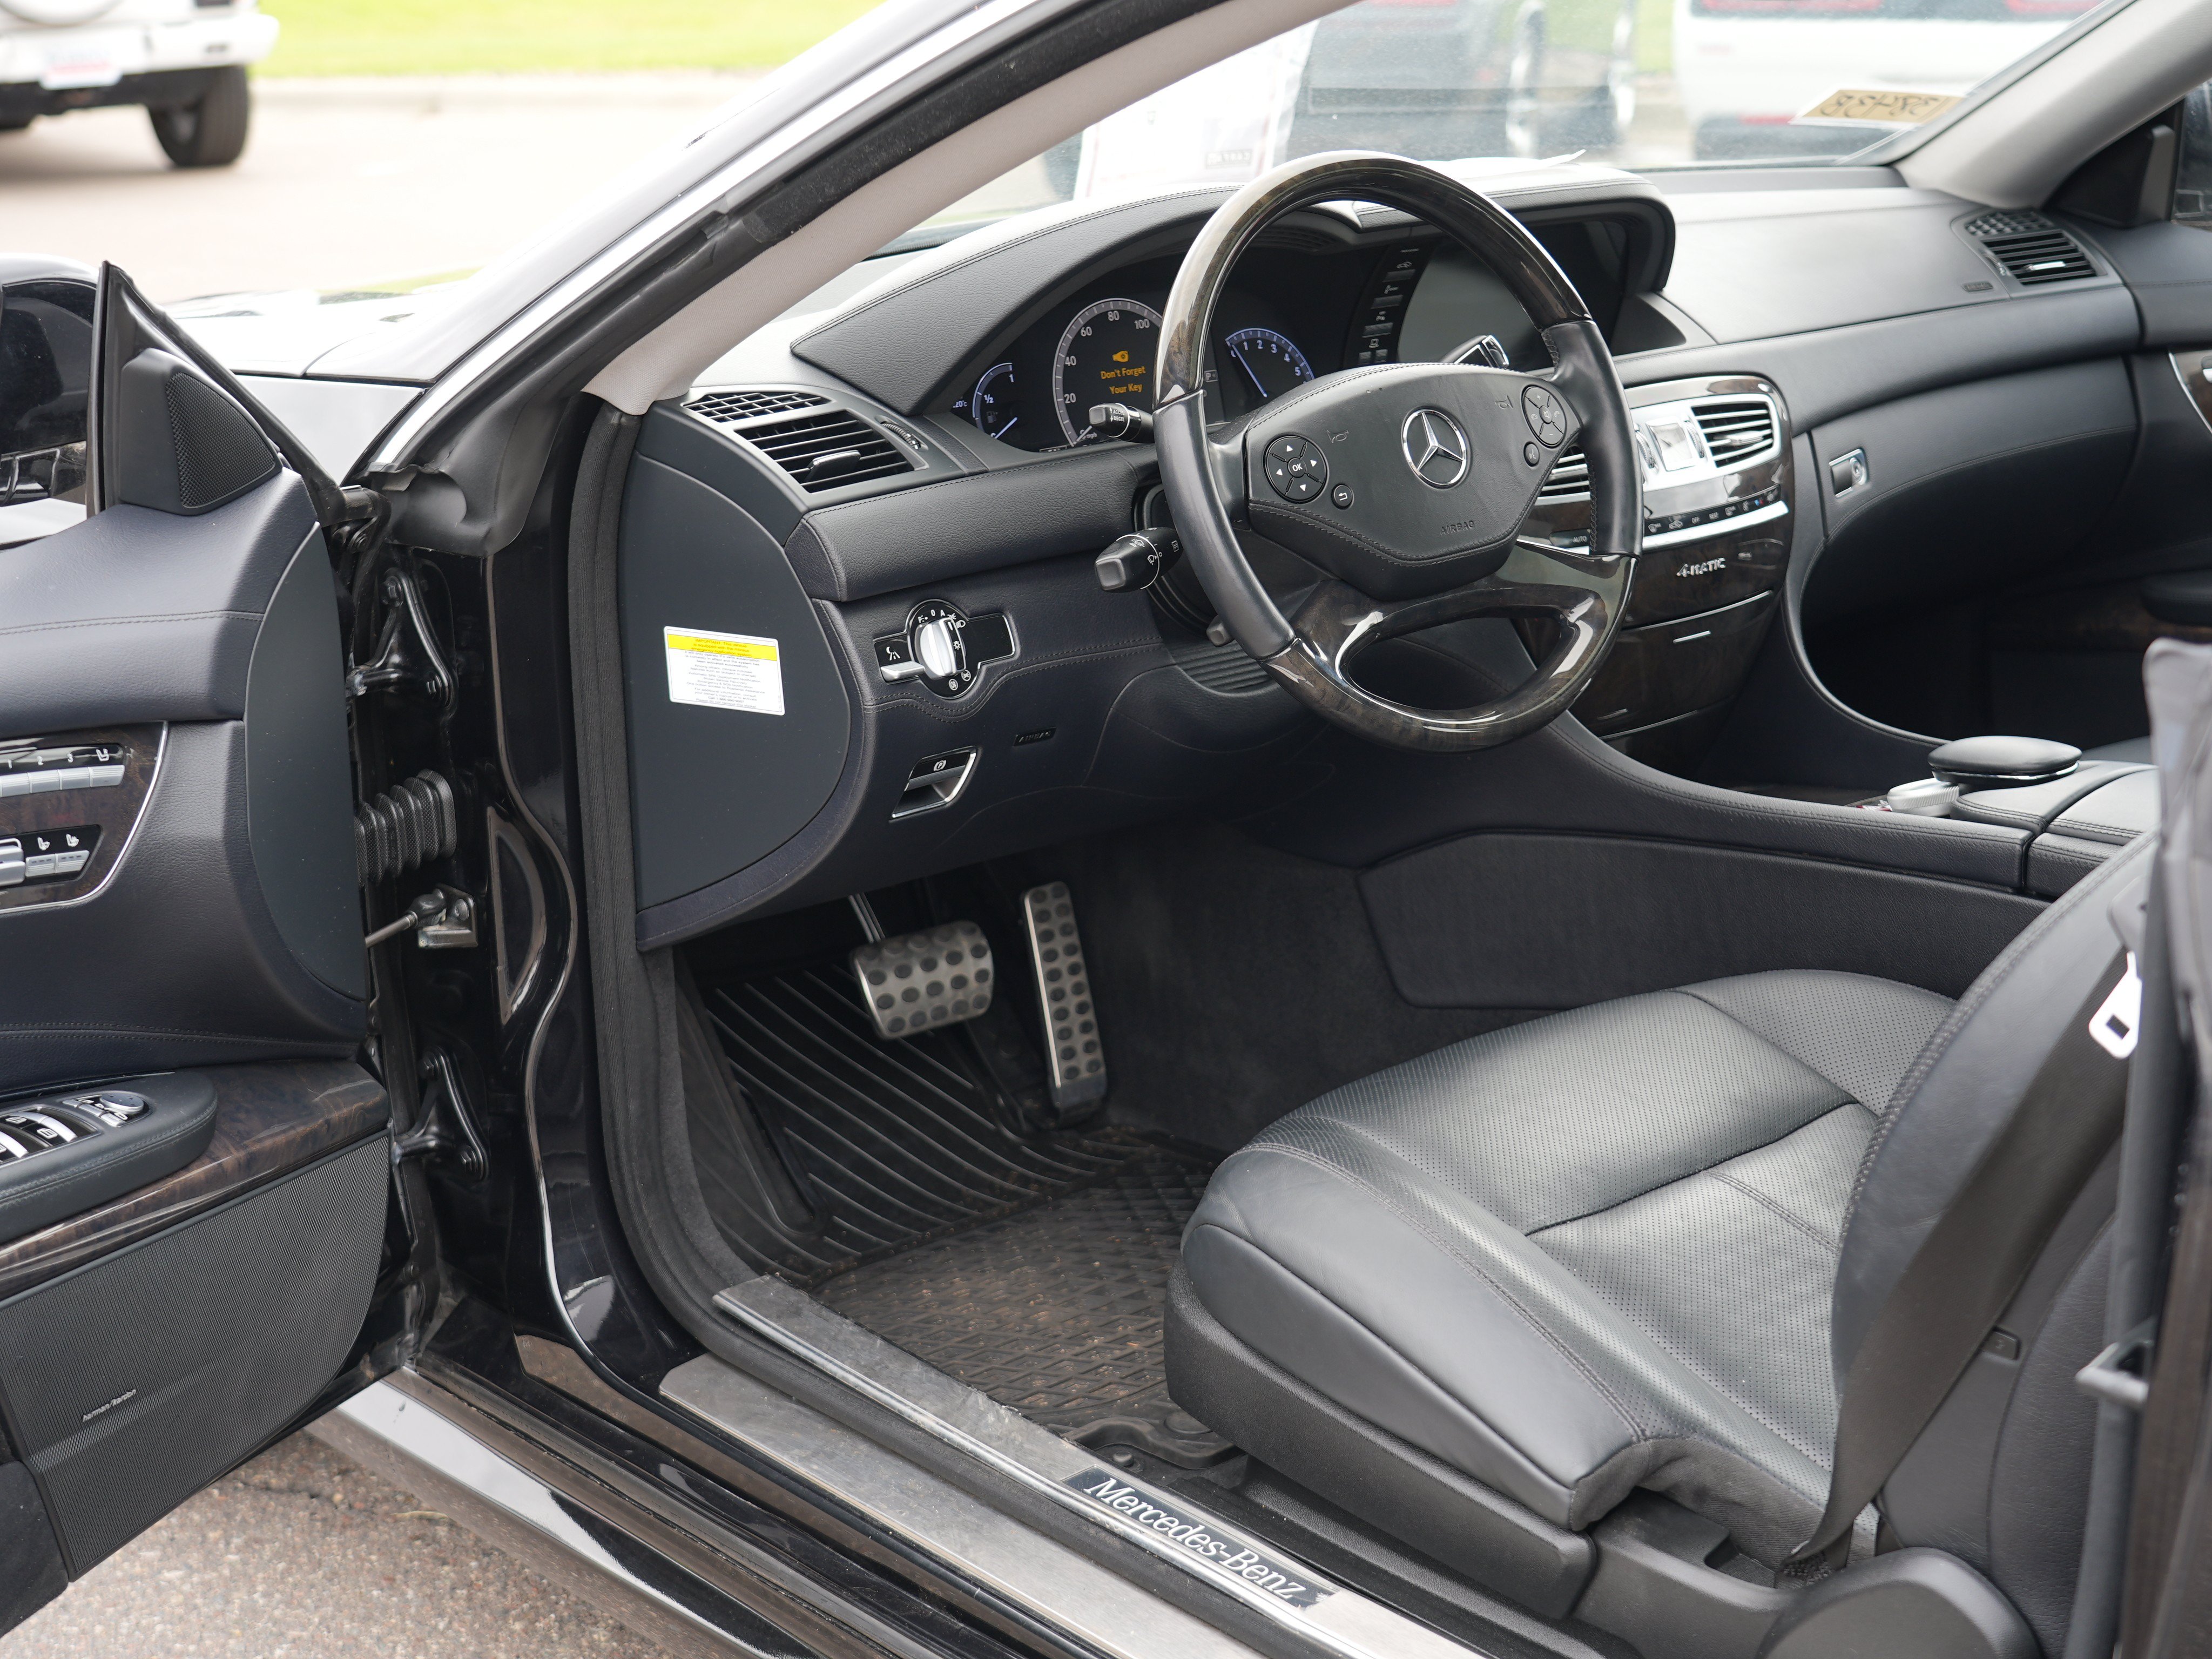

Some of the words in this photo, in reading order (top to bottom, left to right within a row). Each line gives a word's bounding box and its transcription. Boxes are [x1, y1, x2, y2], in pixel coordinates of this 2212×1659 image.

[1108, 310, 1120, 321] 80
[1134, 319, 1150, 329] 100
[1080, 326, 1092, 337] 60
[1243, 341, 1248, 350] 1
[1256, 340, 1264, 349] 2
[1271, 343, 1278, 354] 3
[1064, 355, 1077, 366] 40
[1284, 353, 1290, 362] 4
[1100, 369, 1122, 380] Don't
[1122, 366, 1147, 377] Forget
[1294, 367, 1301, 376] 5
[1008, 375, 1015, 383] 1
[1109, 386, 1127, 395] Your
[1128, 383, 1144, 393] Key
[1064, 393, 1077, 404] 20
[1292, 463, 1303, 472] OK
[1691, 516, 1701, 524] OFF
[1709, 512, 1719, 520] REST
[1440, 520, 1476, 536] AIRBAG
[1573, 535, 1588, 543] AUTO
[37, 755, 44, 766] 2
[66, 752, 74, 763] 3
[1083, 1477, 1306, 1599] Mercedes-Benz
